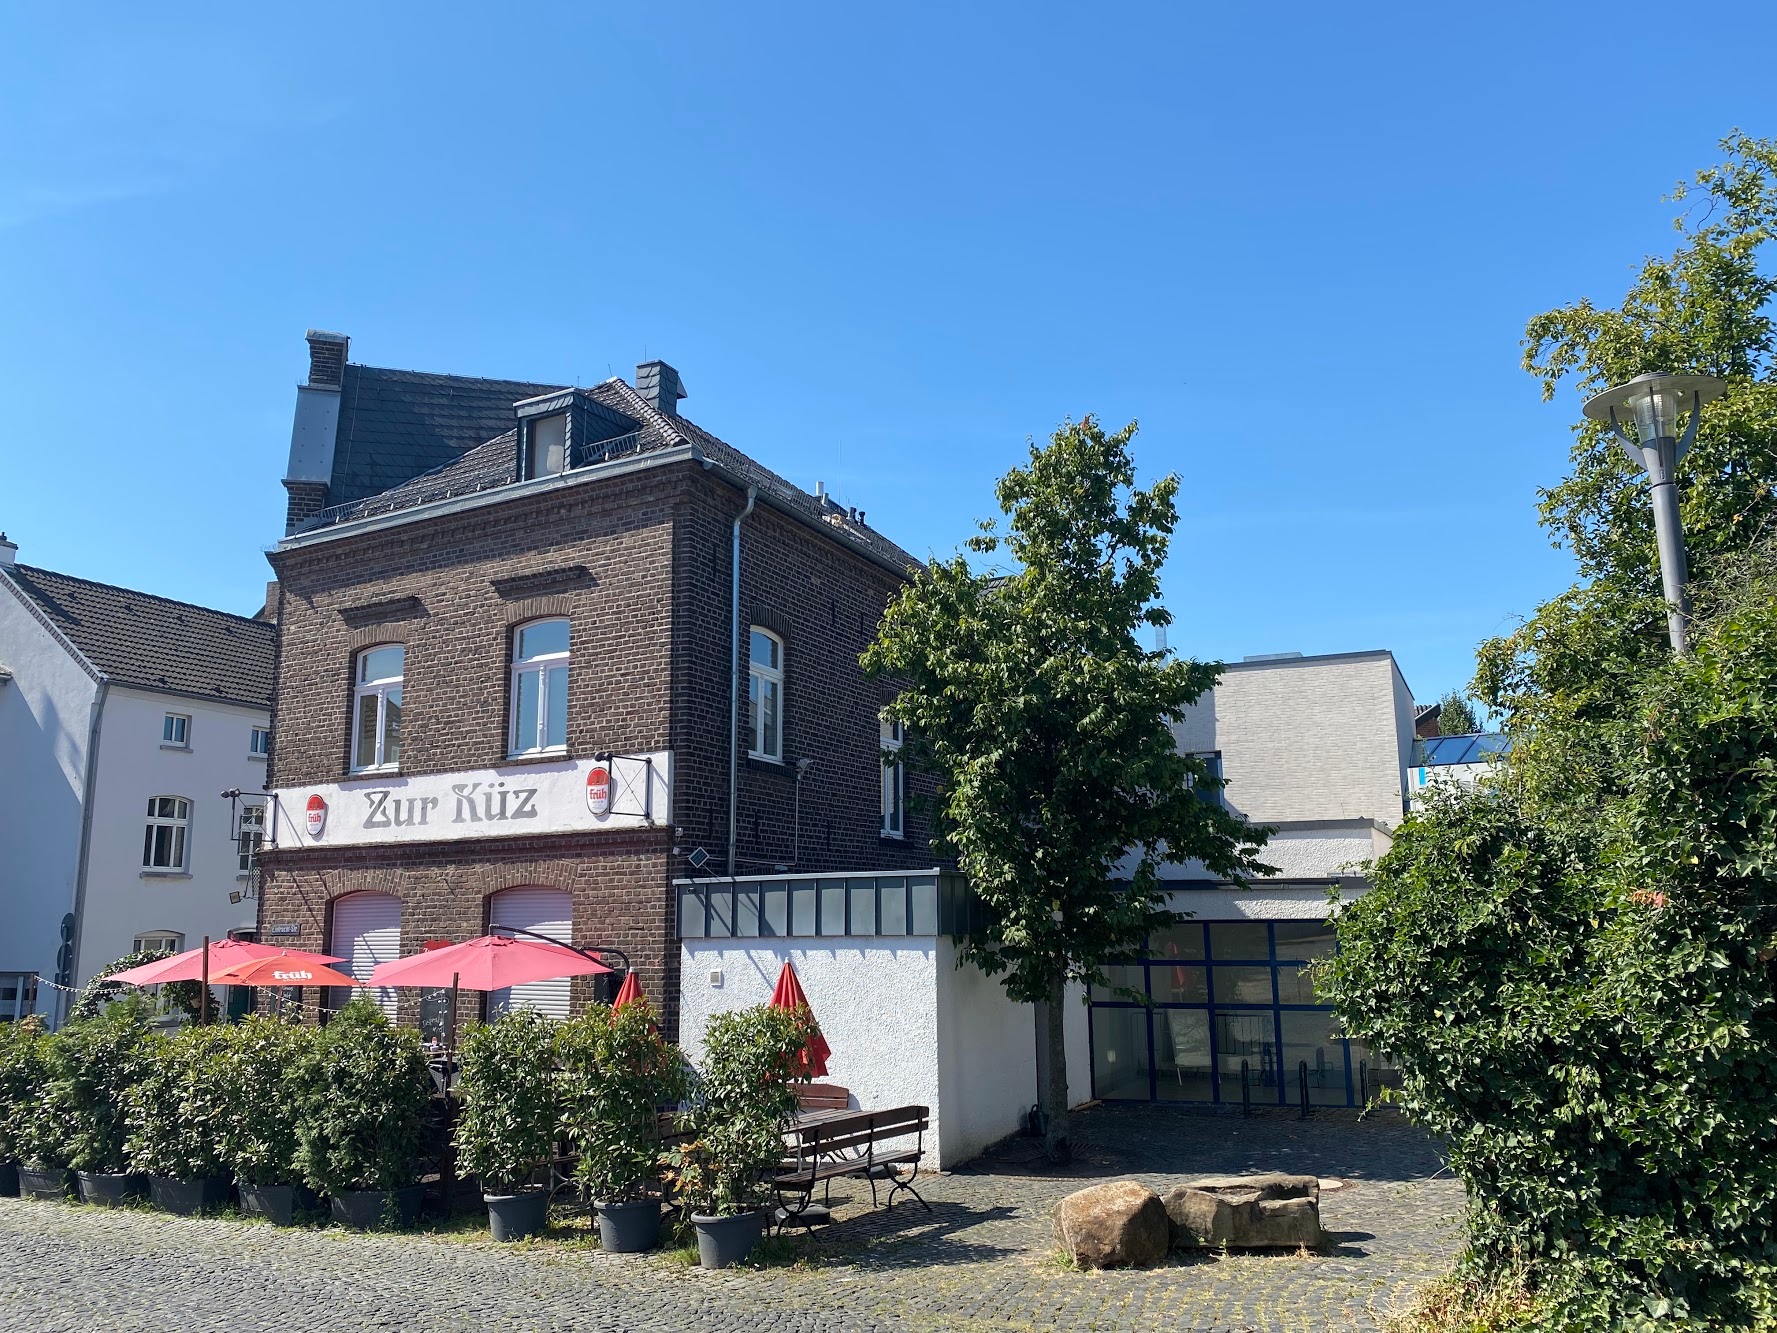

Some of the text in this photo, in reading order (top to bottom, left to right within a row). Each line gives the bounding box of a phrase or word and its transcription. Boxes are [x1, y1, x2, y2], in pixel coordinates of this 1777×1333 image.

[589, 788, 607, 800] früh
[362, 781, 539, 830] Zur Küz
[307, 812, 322, 824] früh
[272, 970, 313, 980] früh
